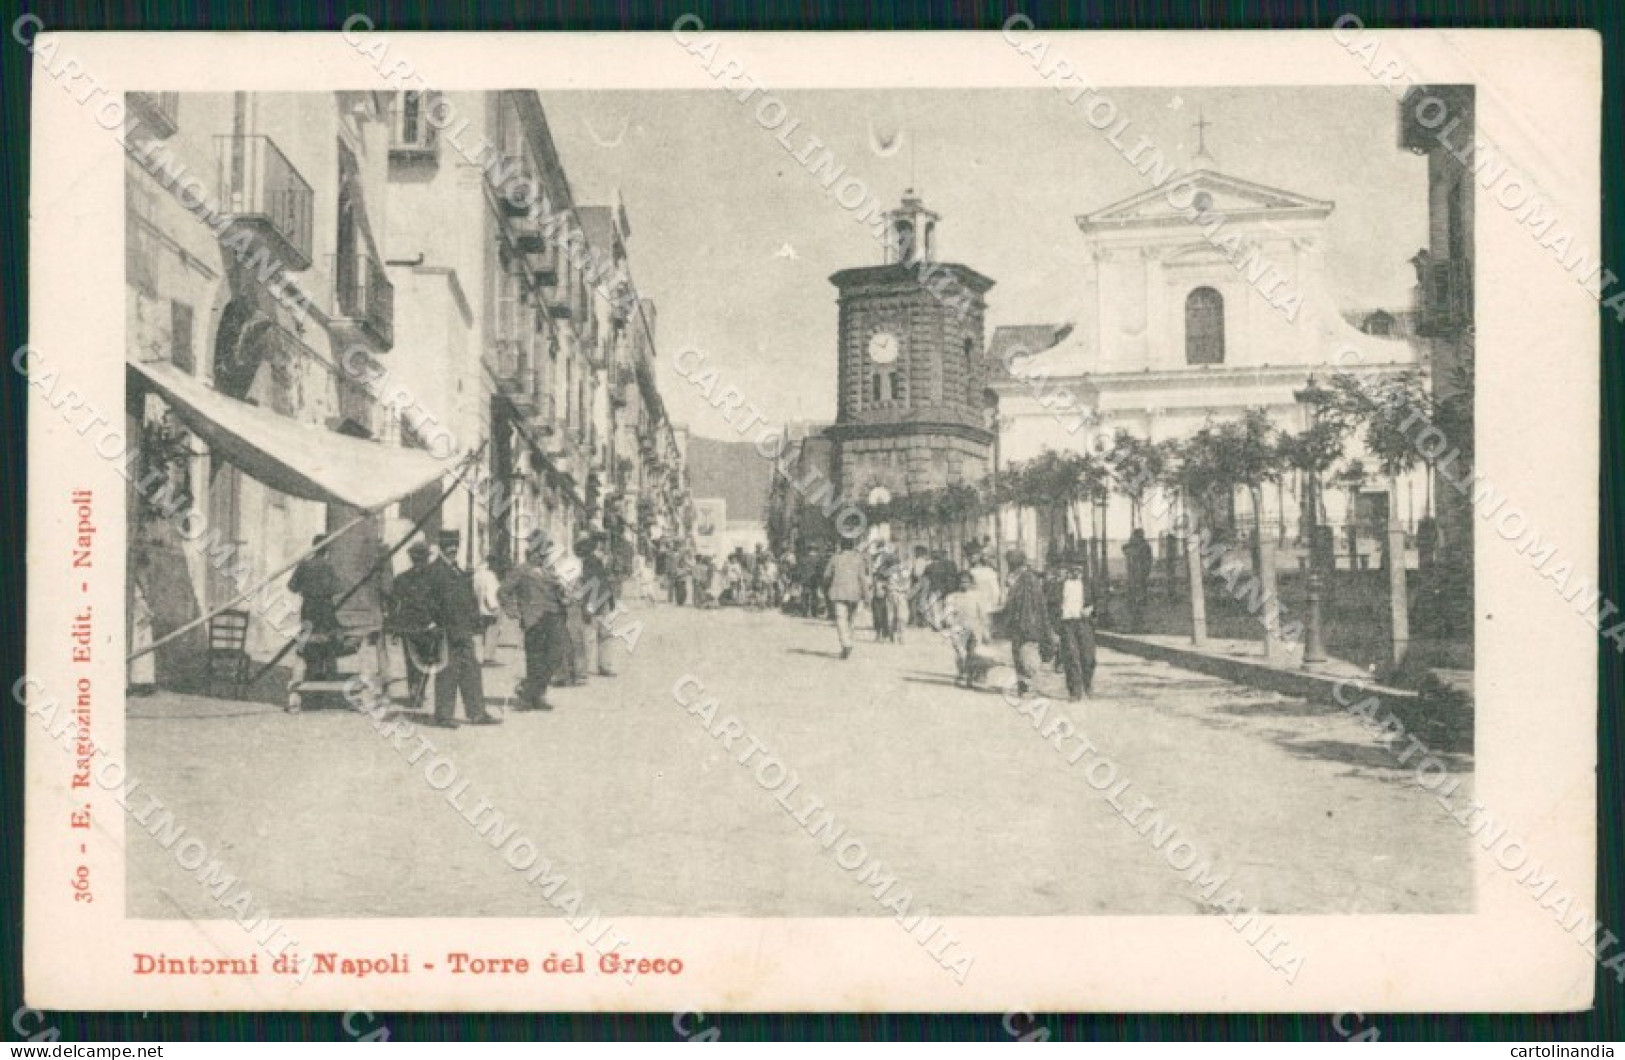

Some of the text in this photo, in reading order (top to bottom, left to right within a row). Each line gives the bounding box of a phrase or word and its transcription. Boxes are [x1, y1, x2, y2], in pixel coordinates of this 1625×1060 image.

[73, 489, 97, 568] Napoli
[72, 605, 92, 664] Edit.
[71, 677, 96, 789] Ragozino
[71, 802, 92, 830] E.
[73, 865, 92, 904] 360
[133, 952, 259, 975] Dintorni
[272, 952, 298, 975] di
[313, 952, 410, 978] Napoli
[447, 953, 529, 975] Torre
[542, 953, 585, 975] del
[598, 953, 684, 976] Greco
